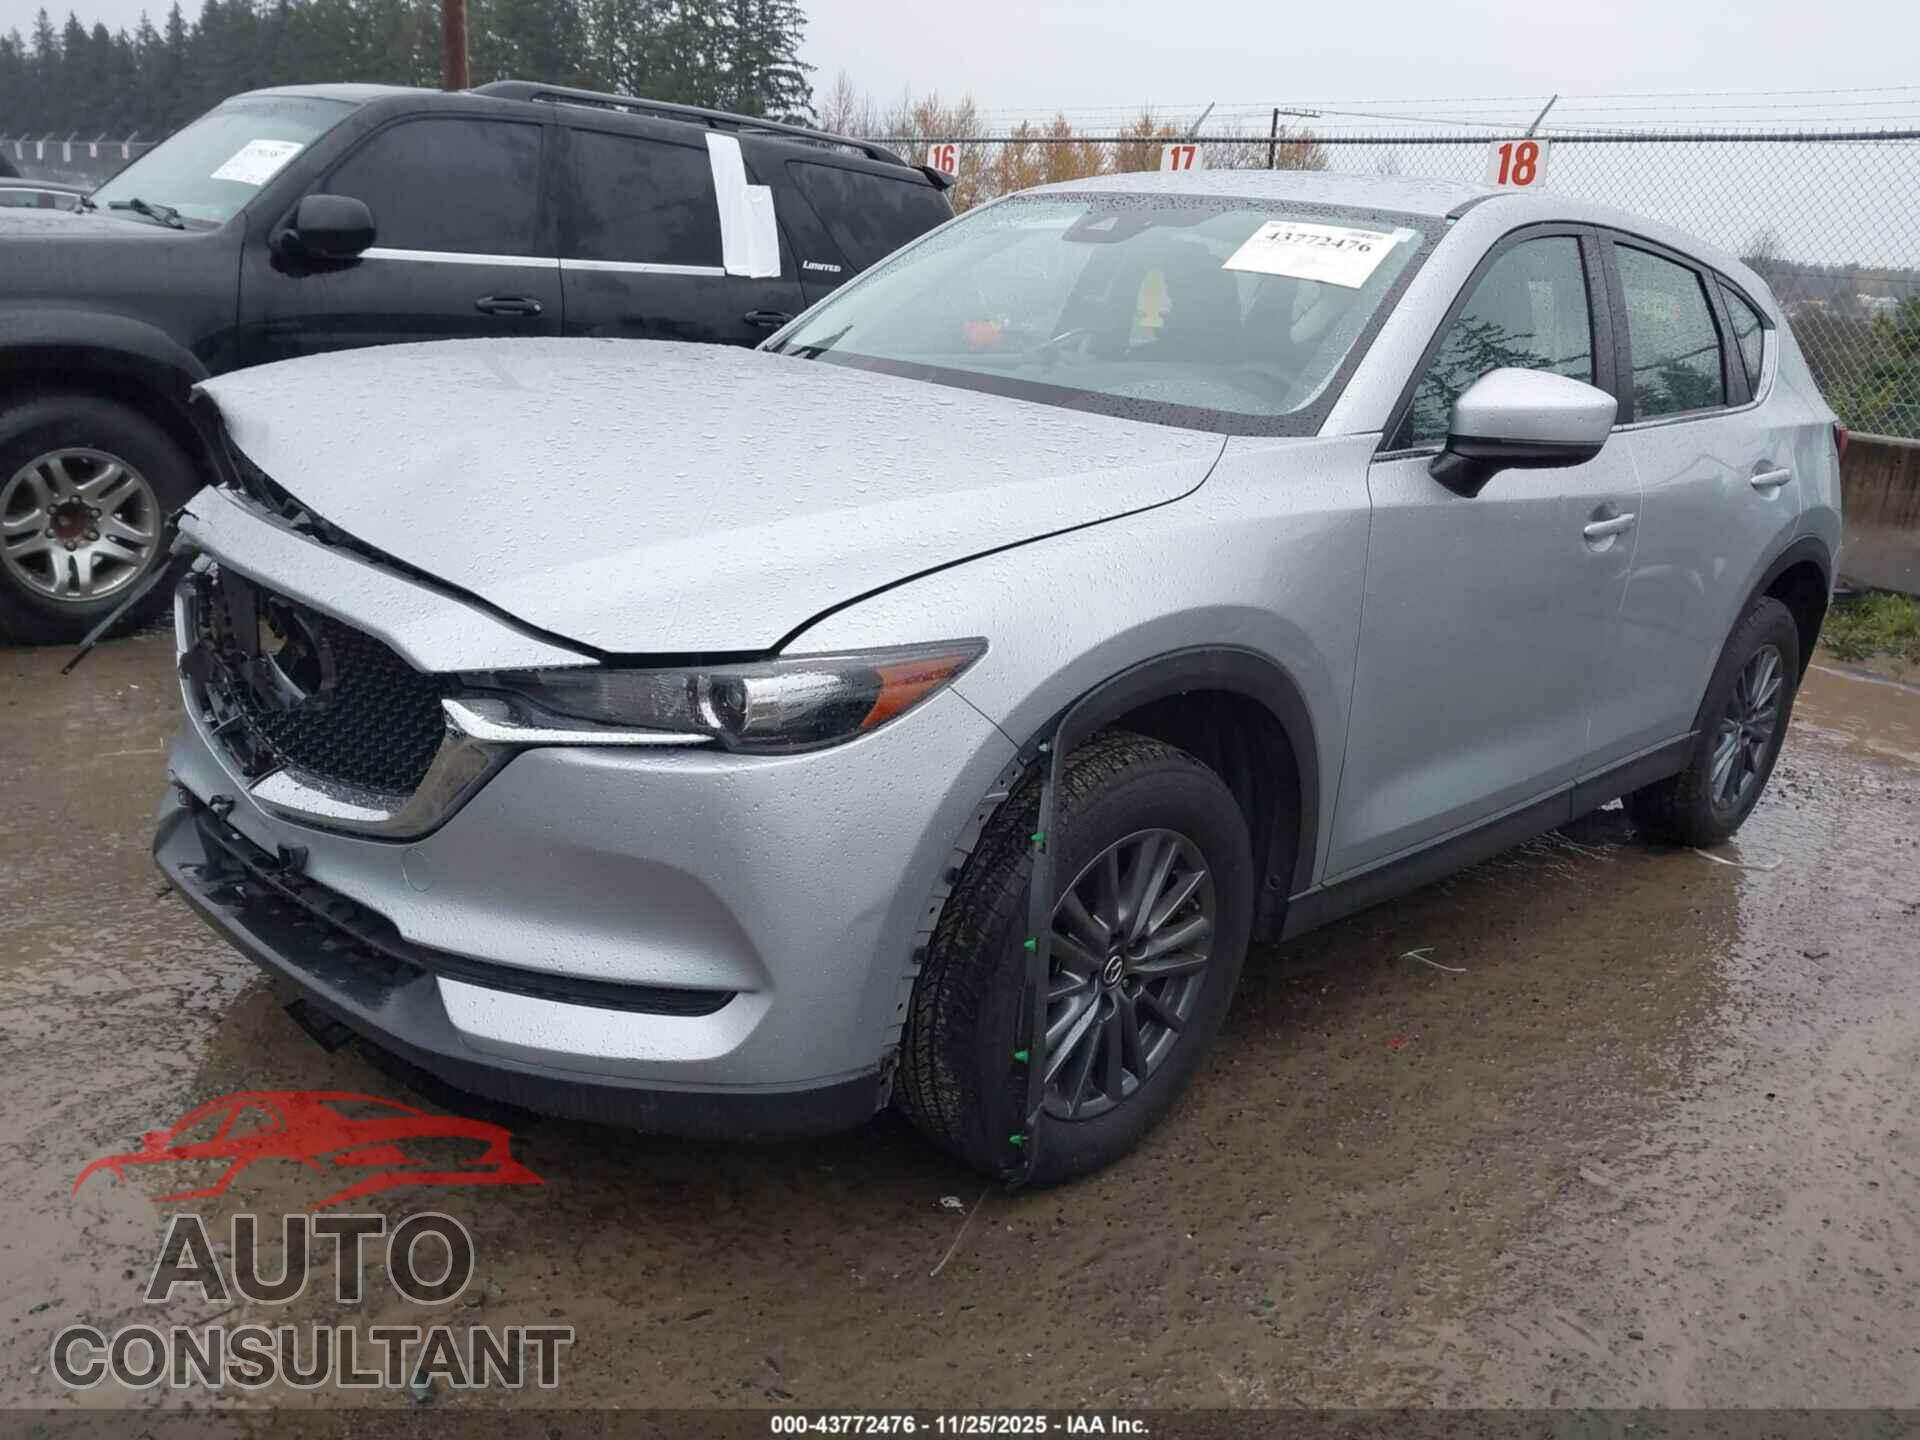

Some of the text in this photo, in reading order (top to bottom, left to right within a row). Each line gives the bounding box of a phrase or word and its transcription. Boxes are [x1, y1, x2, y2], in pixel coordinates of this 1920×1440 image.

[934, 144, 955, 173] 16
[1170, 146, 1196, 171] 17
[1498, 141, 1539, 186] 18
[1265, 231, 1372, 252] 43772476
